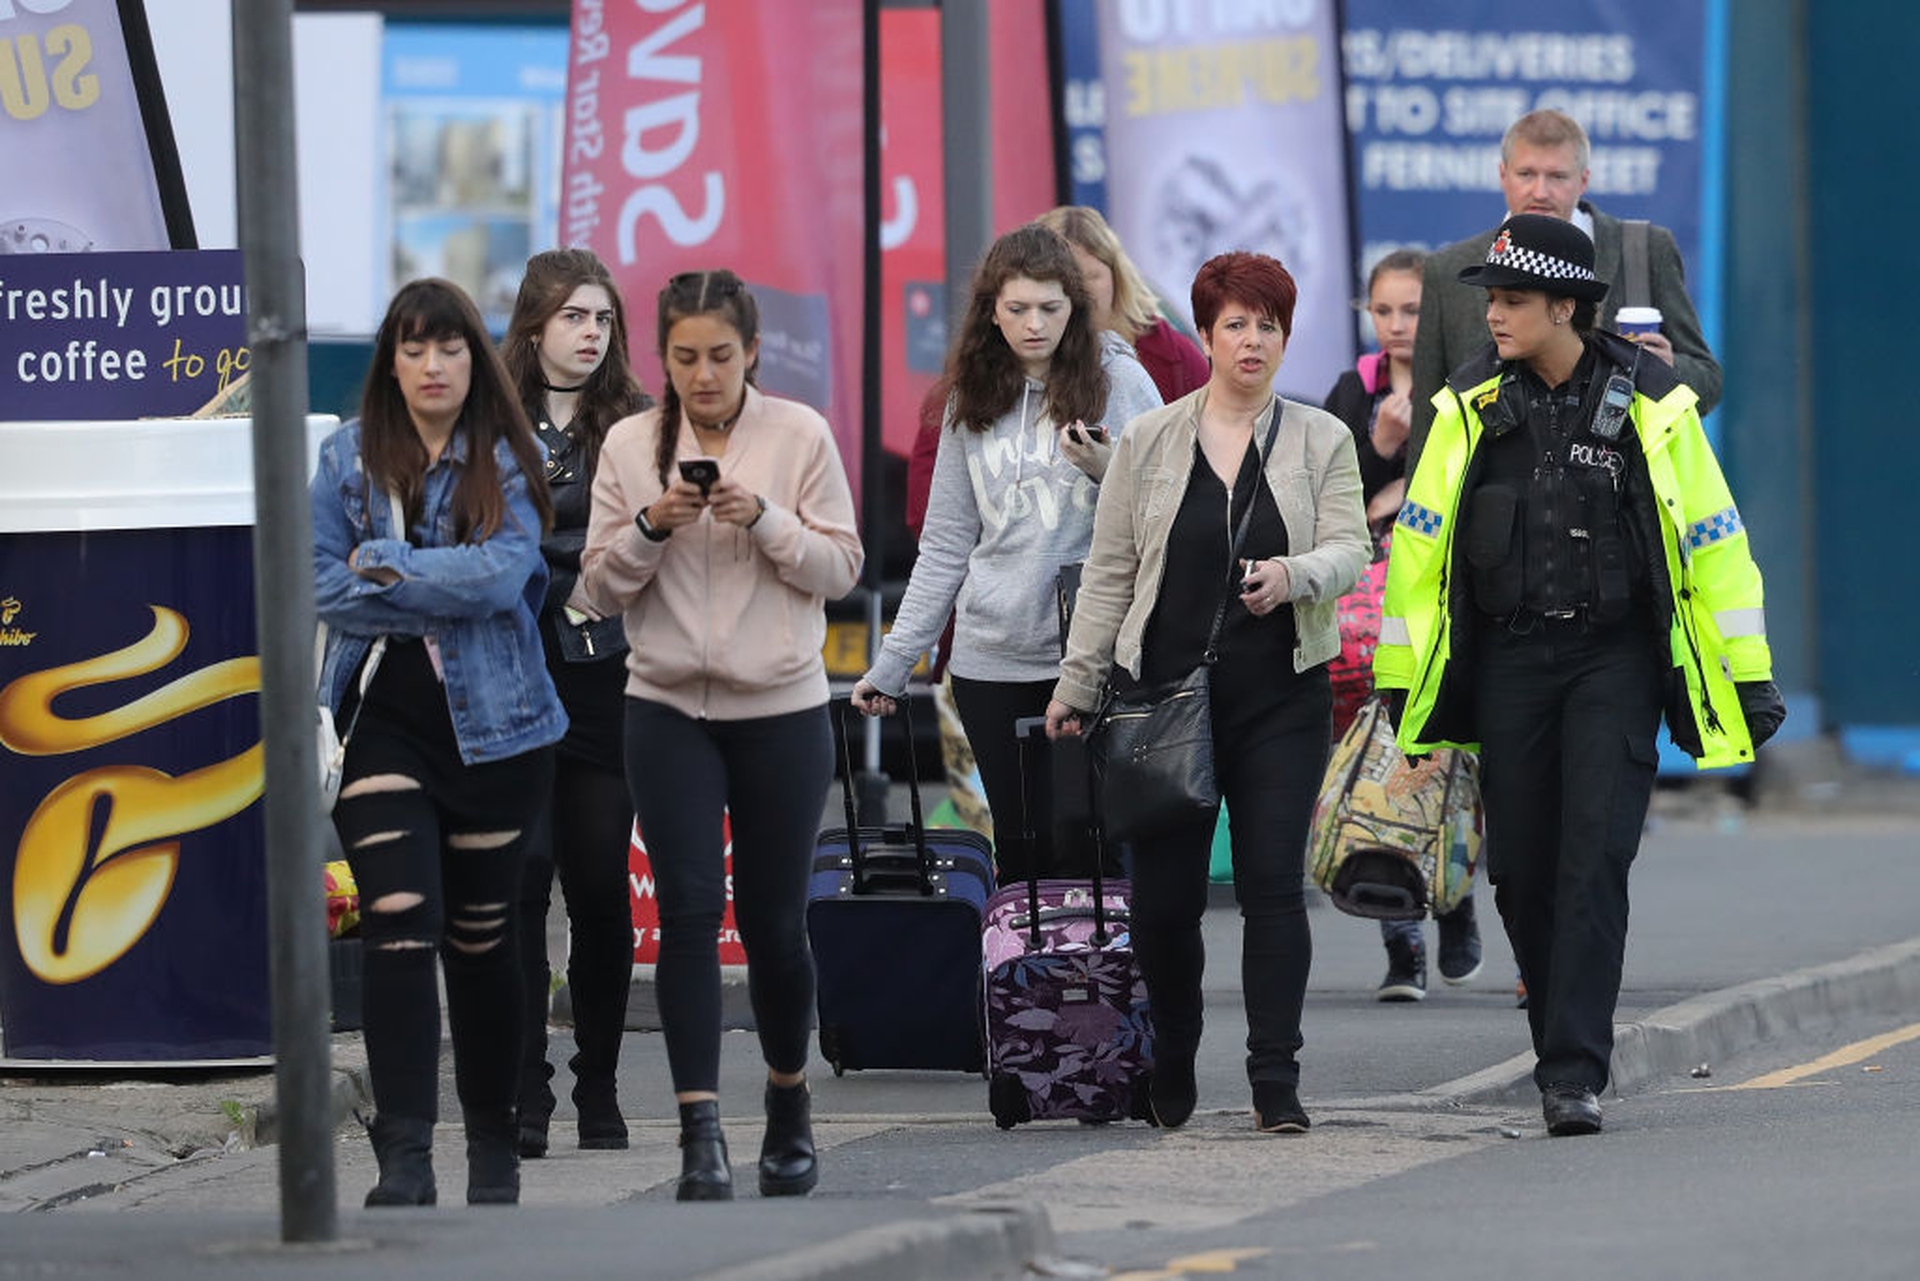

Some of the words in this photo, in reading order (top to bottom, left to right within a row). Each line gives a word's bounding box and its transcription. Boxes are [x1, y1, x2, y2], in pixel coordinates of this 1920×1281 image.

[1375, 84, 1440, 136] TO
[0, 278, 134, 327] reshly
[151, 284, 250, 327] grou
[17, 340, 147, 383] coffee
[162, 338, 204, 382] to
[0, 628, 38, 646] hibo
